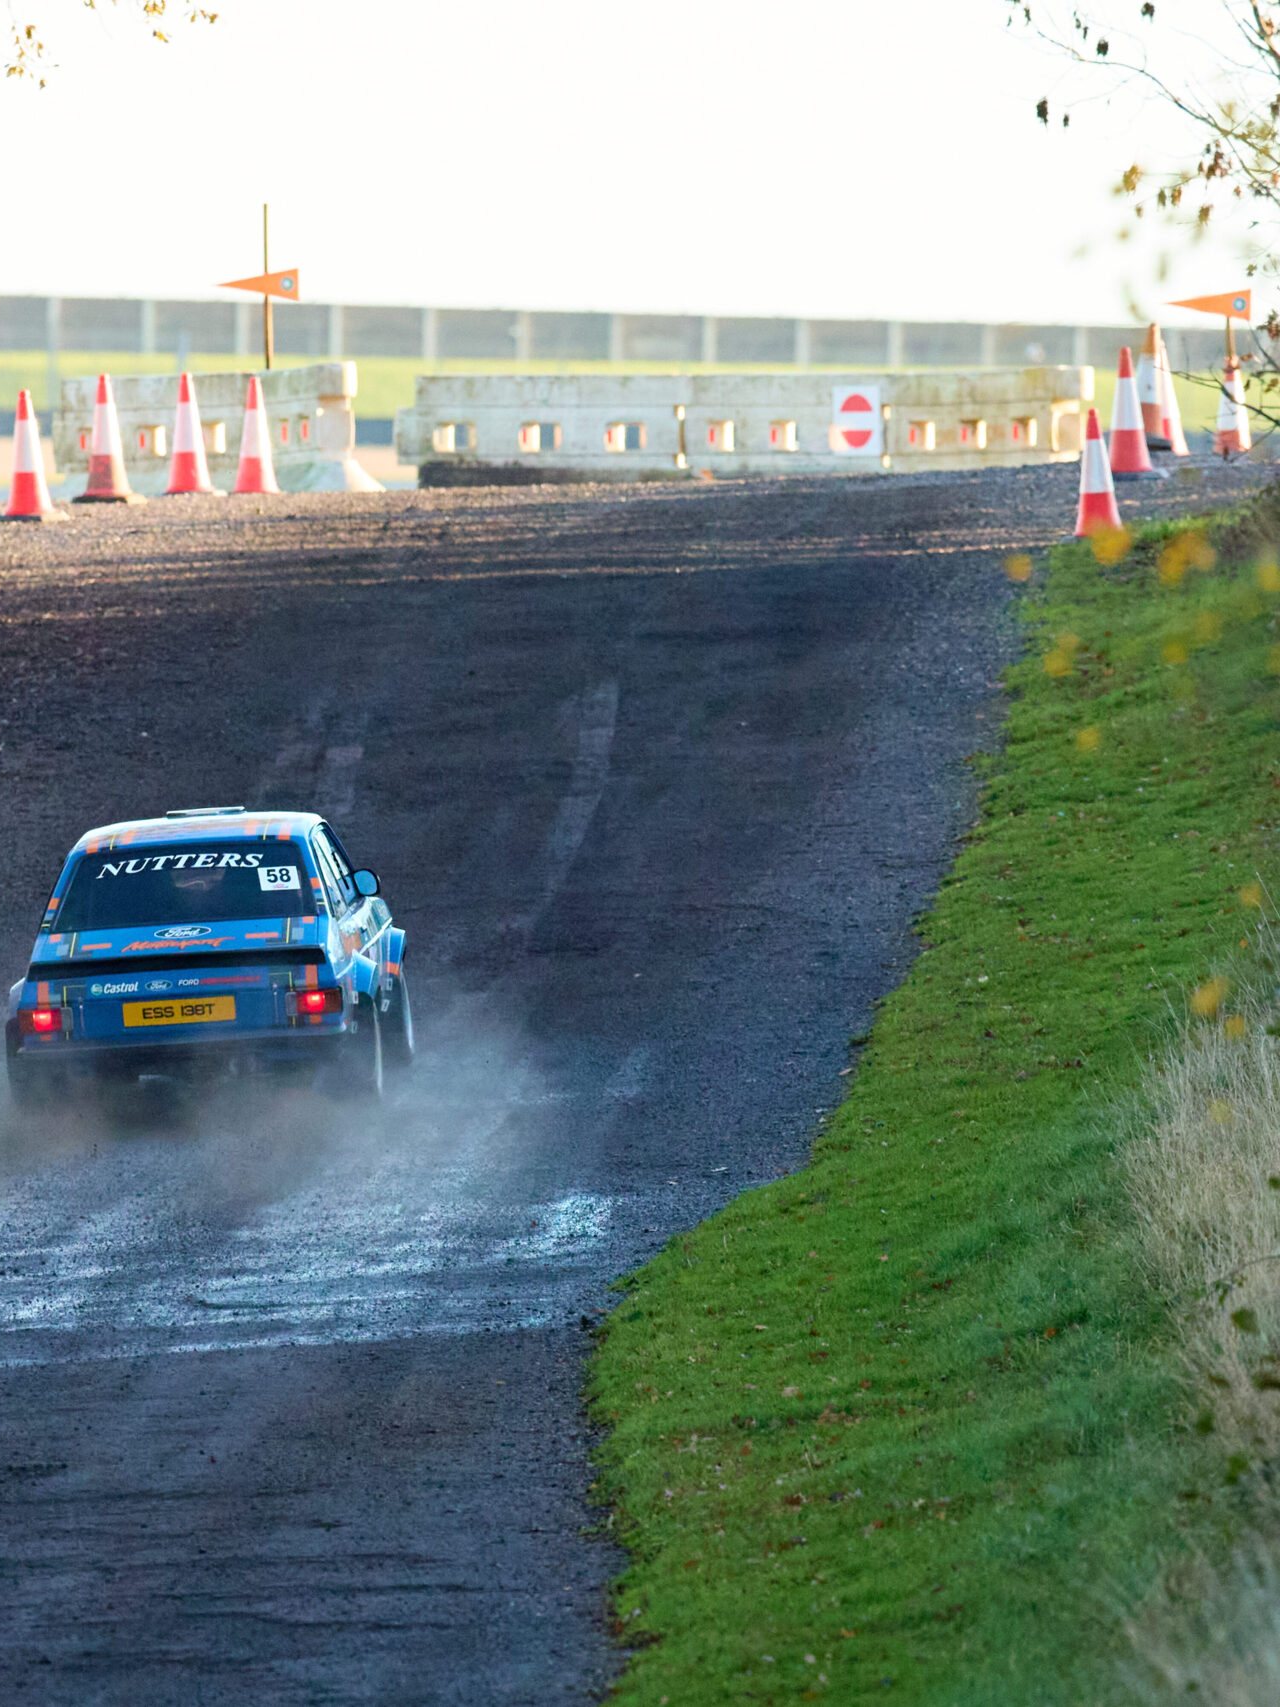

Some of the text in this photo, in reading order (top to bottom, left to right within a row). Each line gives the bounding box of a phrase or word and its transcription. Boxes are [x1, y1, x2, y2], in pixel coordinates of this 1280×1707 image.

[96, 852, 264, 879] NUTTERS
[266, 868, 291, 883] 58
[103, 981, 139, 994] Castrol
[178, 978, 200, 987] FORD
[142, 1003, 215, 1019] ESS 138T
